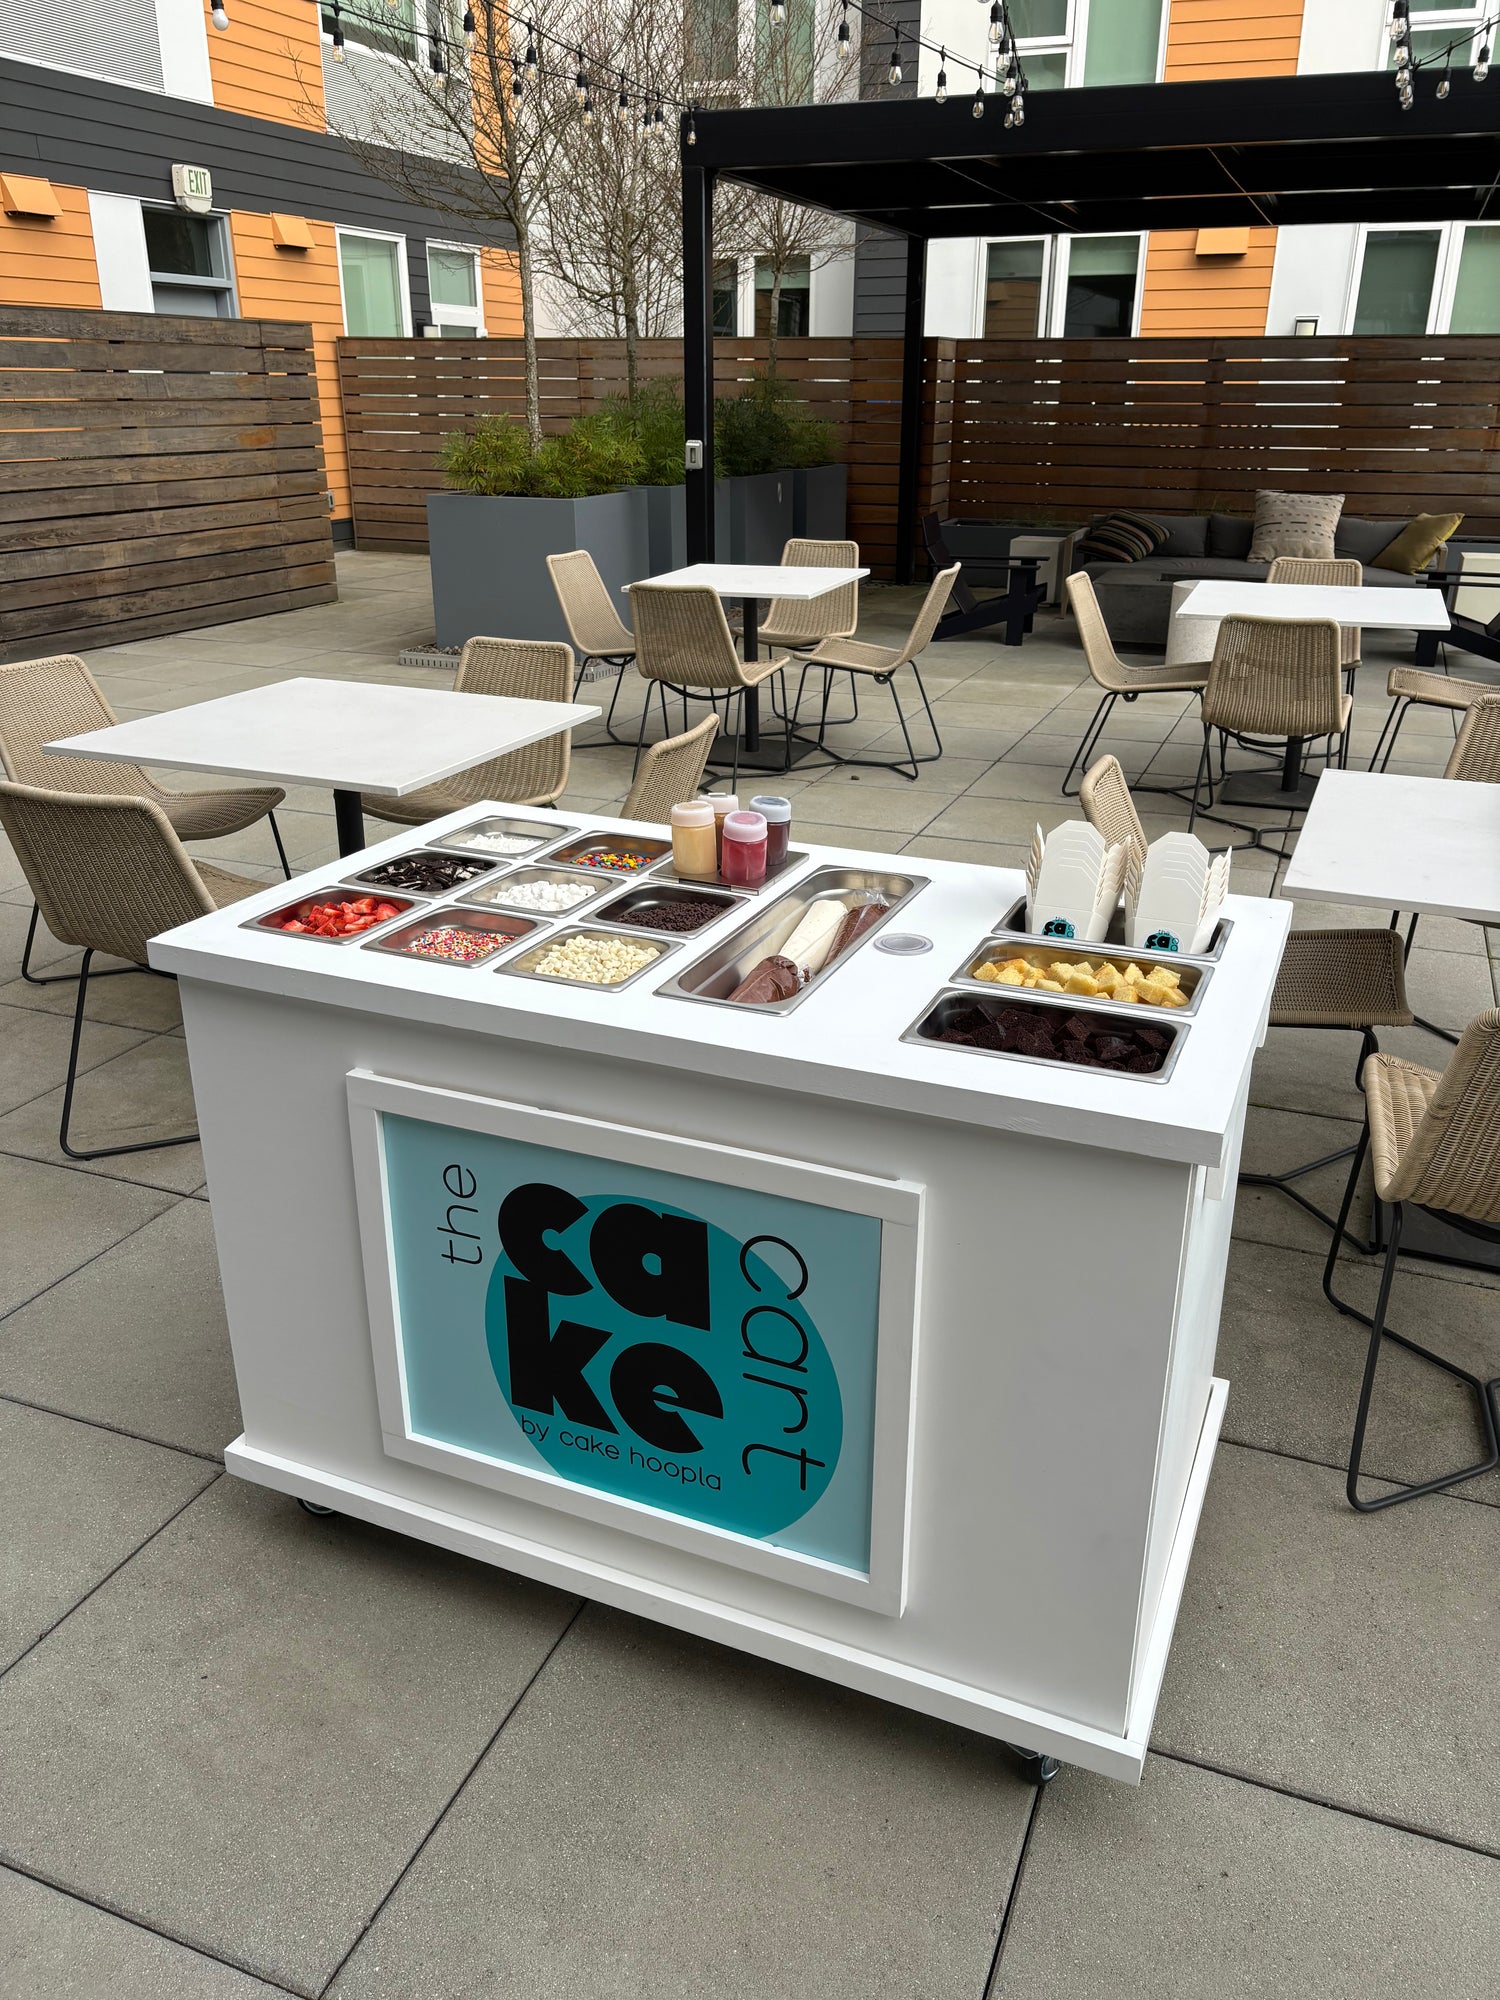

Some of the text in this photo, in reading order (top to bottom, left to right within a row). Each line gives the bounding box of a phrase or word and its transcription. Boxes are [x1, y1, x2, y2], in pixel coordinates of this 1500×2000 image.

[188, 169, 207, 195] EXIT
[436, 1163, 483, 1265] the
[521, 1414, 721, 1491] by cake hoopla
